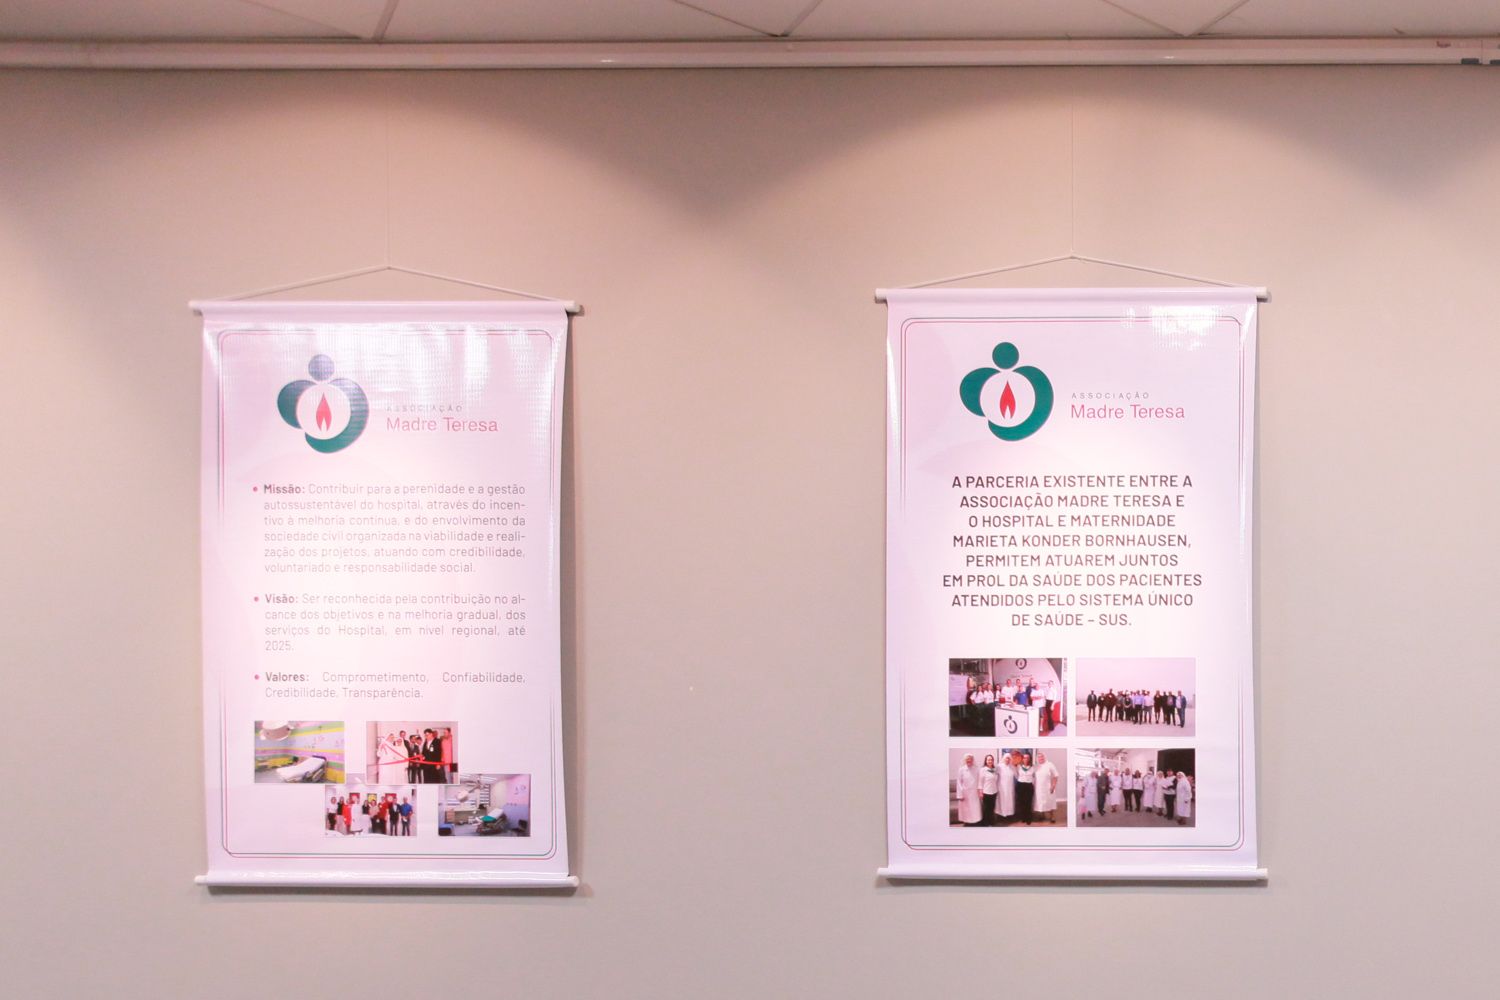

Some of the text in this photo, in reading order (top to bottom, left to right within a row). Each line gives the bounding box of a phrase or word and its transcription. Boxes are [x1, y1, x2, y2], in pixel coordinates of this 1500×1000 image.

[1072, 391, 1149, 400] ASSOCIAÇÃO
[1071, 404, 1185, 419] Madre Teresa
[386, 417, 498, 432] Madre Teresa
[952, 475, 1192, 488] A PARCERIA EXISTENTE ENTRE A
[308, 483, 364, 494] Contribuir
[367, 486, 391, 495] para
[403, 483, 465, 496] perenidade
[487, 484, 525, 496] gestão
[490, 500, 525, 510] incen-
[959, 492, 1184, 510] ASSOCIAÇÃO MADRE TERESA E
[264, 515, 525, 526] tivo melhoria envolvimento da
[969, 514, 1175, 527] O HOSPITAL E MATERNIDADE
[264, 531, 525, 543] sociedade civil organizada viabilidade reali-
[953, 534, 1191, 548] MARIETA KONDER BORNHAUSEN,
[264, 546, 295, 558] zação
[299, 547, 317, 556] dos
[374, 547, 418, 556] atuando
[422, 548, 445, 556] com
[966, 554, 1178, 567] PERMITEM ATUAREM JUNTOS
[264, 562, 331, 572] voluntariado
[343, 562, 437, 574] responsabilidade
[943, 572, 1202, 587] EM PROL DA SAÚDE DOS PACIENTES
[302, 593, 320, 603] Ser
[323, 593, 391, 603] reconhecida
[395, 594, 417, 605] pela
[420, 593, 491, 604] contribuição
[511, 594, 525, 604] al-
[951, 591, 1193, 607] ATENDIDOS PELO SISTEMA ÚNICO
[300, 610, 319, 619] dos
[323, 609, 374, 621] objetivos
[405, 609, 452, 619] melhoria
[506, 610, 525, 620] dos
[1011, 611, 1131, 626] DE SAÚDE SUS.
[265, 625, 309, 636] serviços
